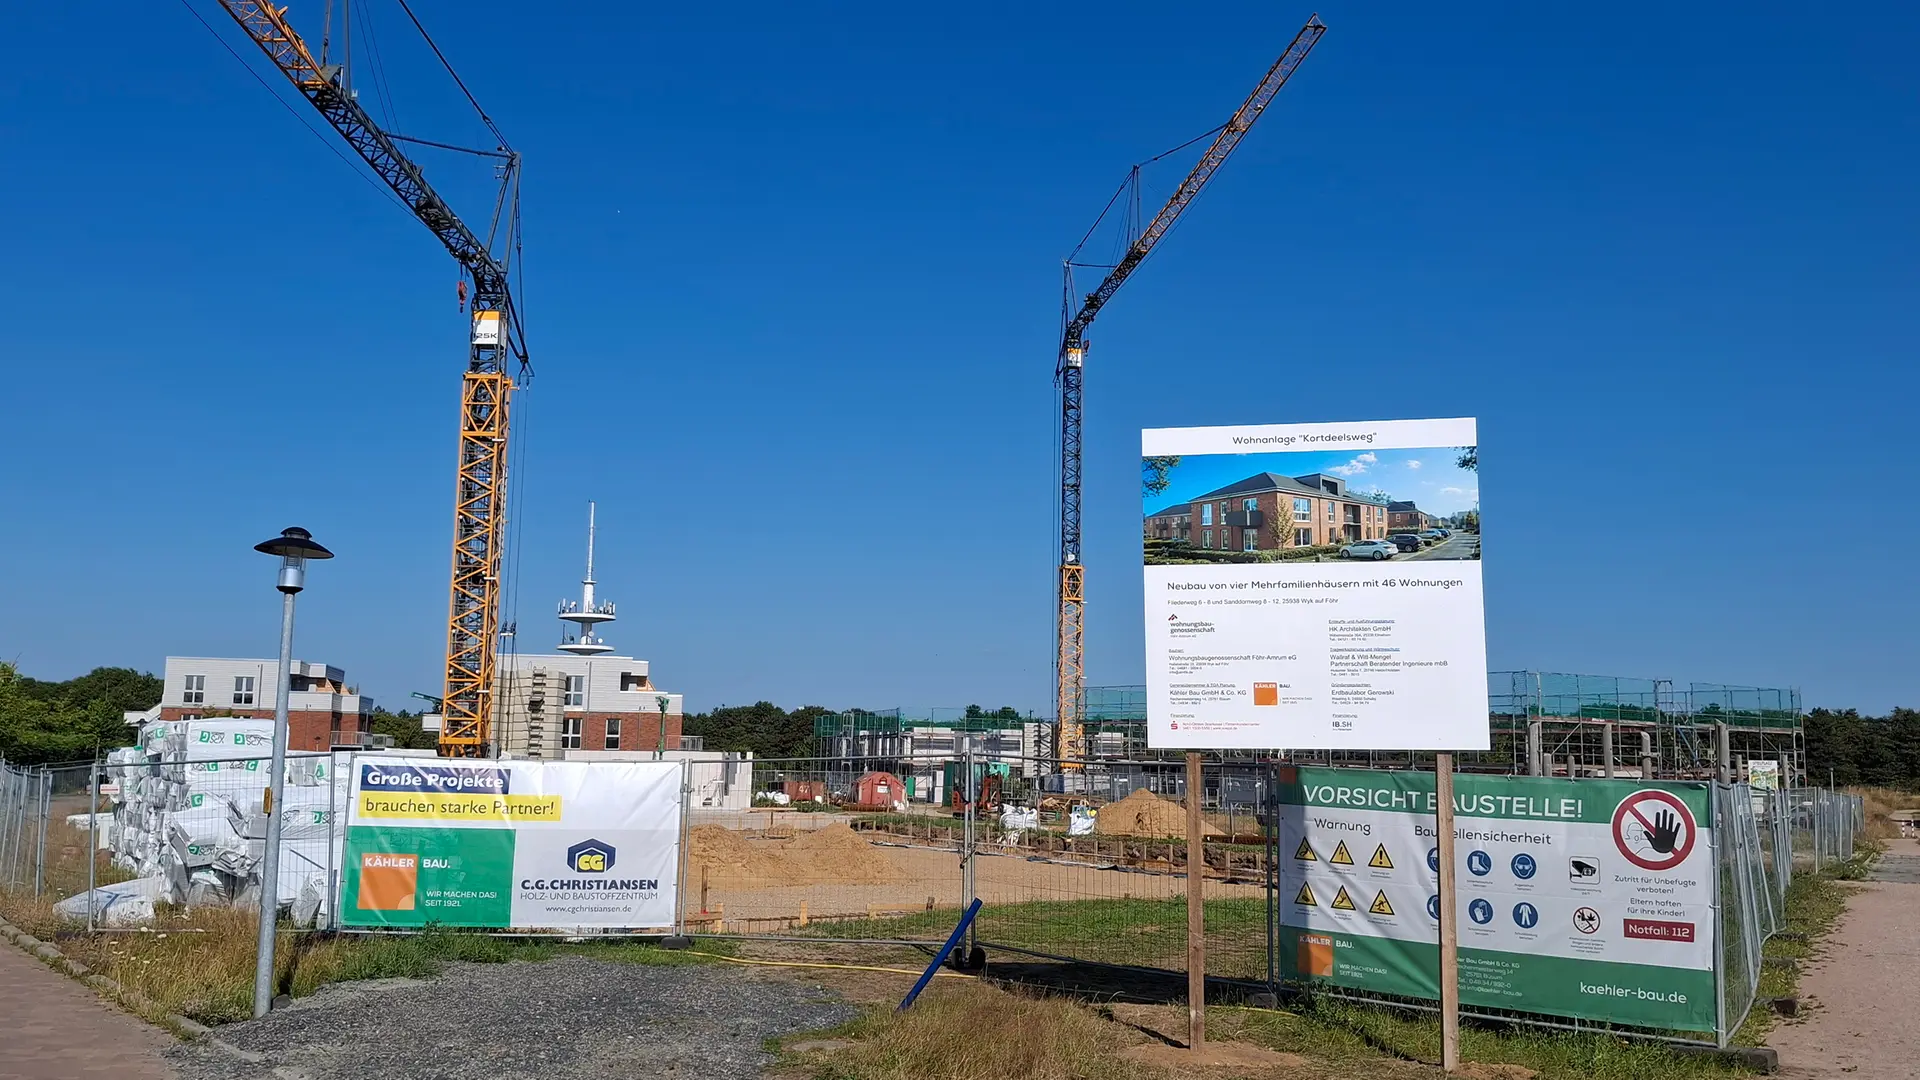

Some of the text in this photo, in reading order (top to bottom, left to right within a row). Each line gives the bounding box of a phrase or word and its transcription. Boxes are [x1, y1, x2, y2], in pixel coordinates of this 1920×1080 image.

[1232, 432, 1378, 446] Wohnanlage "Kortdeelsweg"
[1167, 582, 1206, 591] Neubau
[1230, 581, 1248, 590] vier
[1251, 579, 1360, 589] Mehrfamilienhäusern
[1363, 579, 1379, 588] mit
[1382, 578, 1396, 588] 46
[1399, 578, 1463, 590] Wohnungen
[1170, 621, 1215, 629] wohnungsbau-
[367, 772, 504, 790] Große Projekte
[1303, 785, 1421, 809] VORSICHT
[365, 797, 555, 815] brauchen starke Partner!
[1313, 817, 1552, 845] Warnung Bauellensicherheit
[365, 856, 451, 869] KÄHLER BAU.
[578, 854, 604, 870] CG
[521, 879, 658, 890] C.G.CHRISTIANSEN
[1614, 875, 1697, 888] Zutritt für Unbefugte
[426, 890, 442, 898] WIR
[443, 890, 478, 898] MACHEN
[520, 892, 658, 900] HOLZ- UND BAUSTOFFZENTRUM
[1636, 886, 1674, 894] verboten!
[1630, 898, 1682, 907] Eltern haften
[545, 905, 632, 914] www.cgchristiansen.de
[1627, 907, 1638, 915] für
[1657, 909, 1685, 917] Kinder!
[1628, 924, 1690, 937] Notfall: 112
[1335, 940, 1355, 949] BAU.
[1350, 965, 1374, 973] MACHEN
[1580, 981, 1687, 1004] kaehler-bau.de
